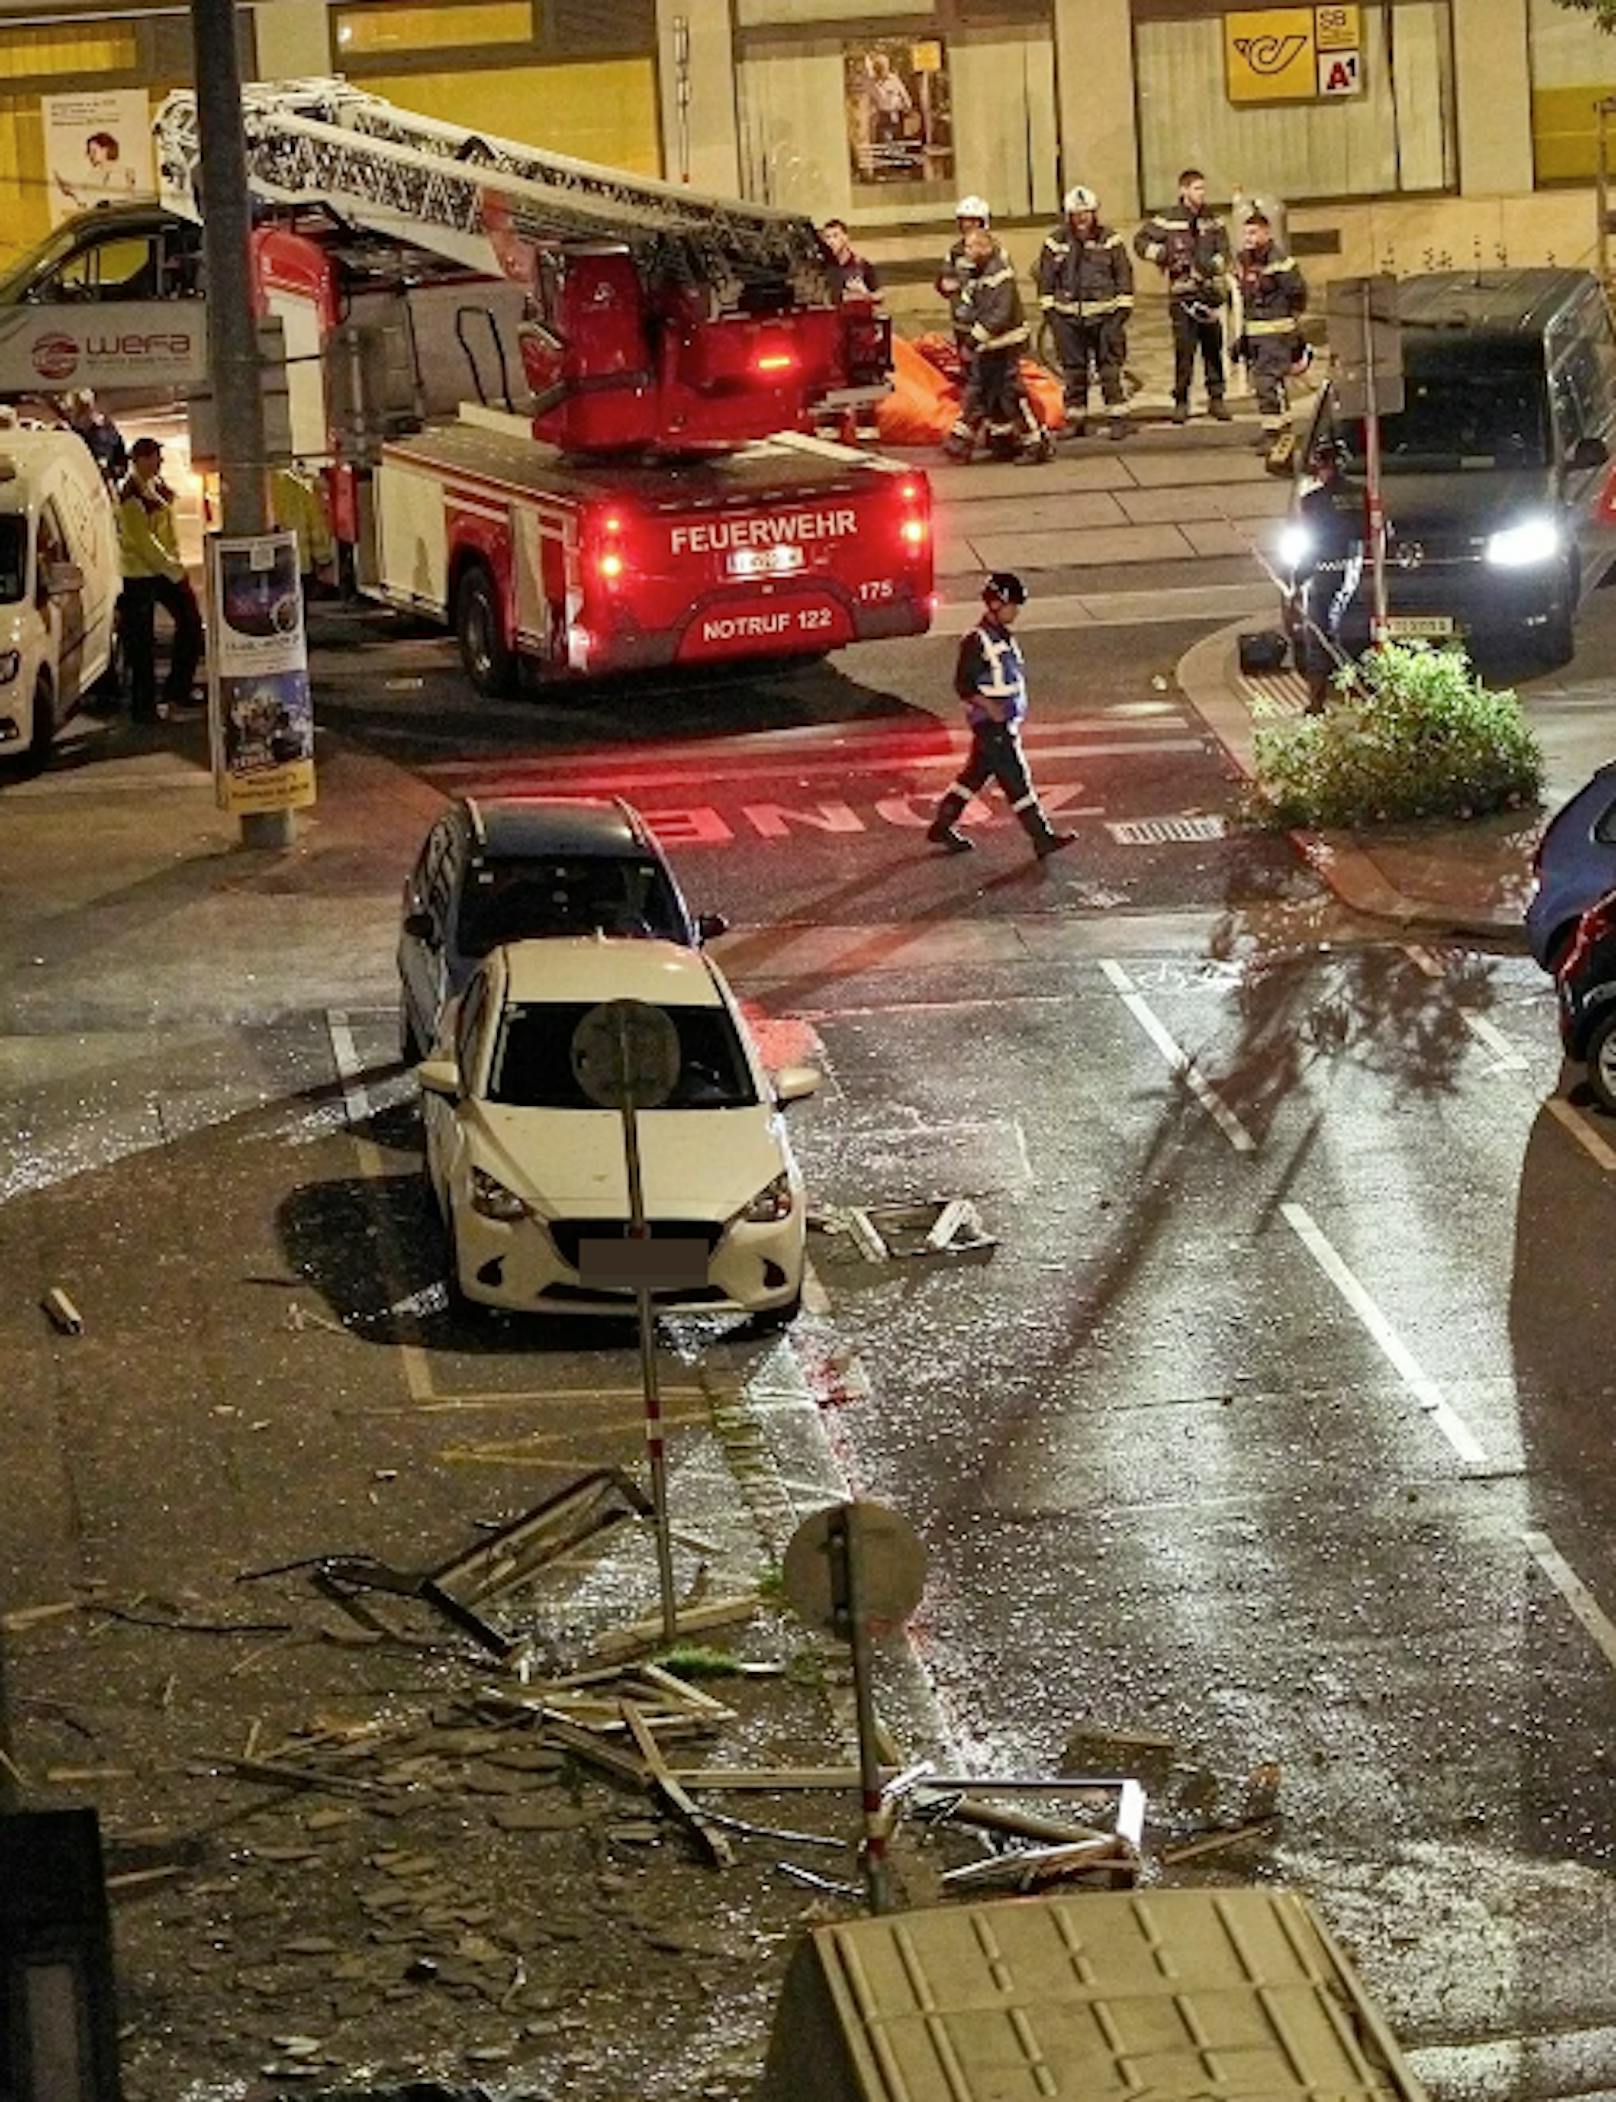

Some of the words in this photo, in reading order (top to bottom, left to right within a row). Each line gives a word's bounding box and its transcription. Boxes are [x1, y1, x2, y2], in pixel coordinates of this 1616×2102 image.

[1327, 57, 1356, 90] A1
[671, 510, 858, 555] FEUERWEHR
[859, 580, 893, 601] 175
[703, 613, 791, 642] NOTRUF
[797, 608, 832, 630] 122
